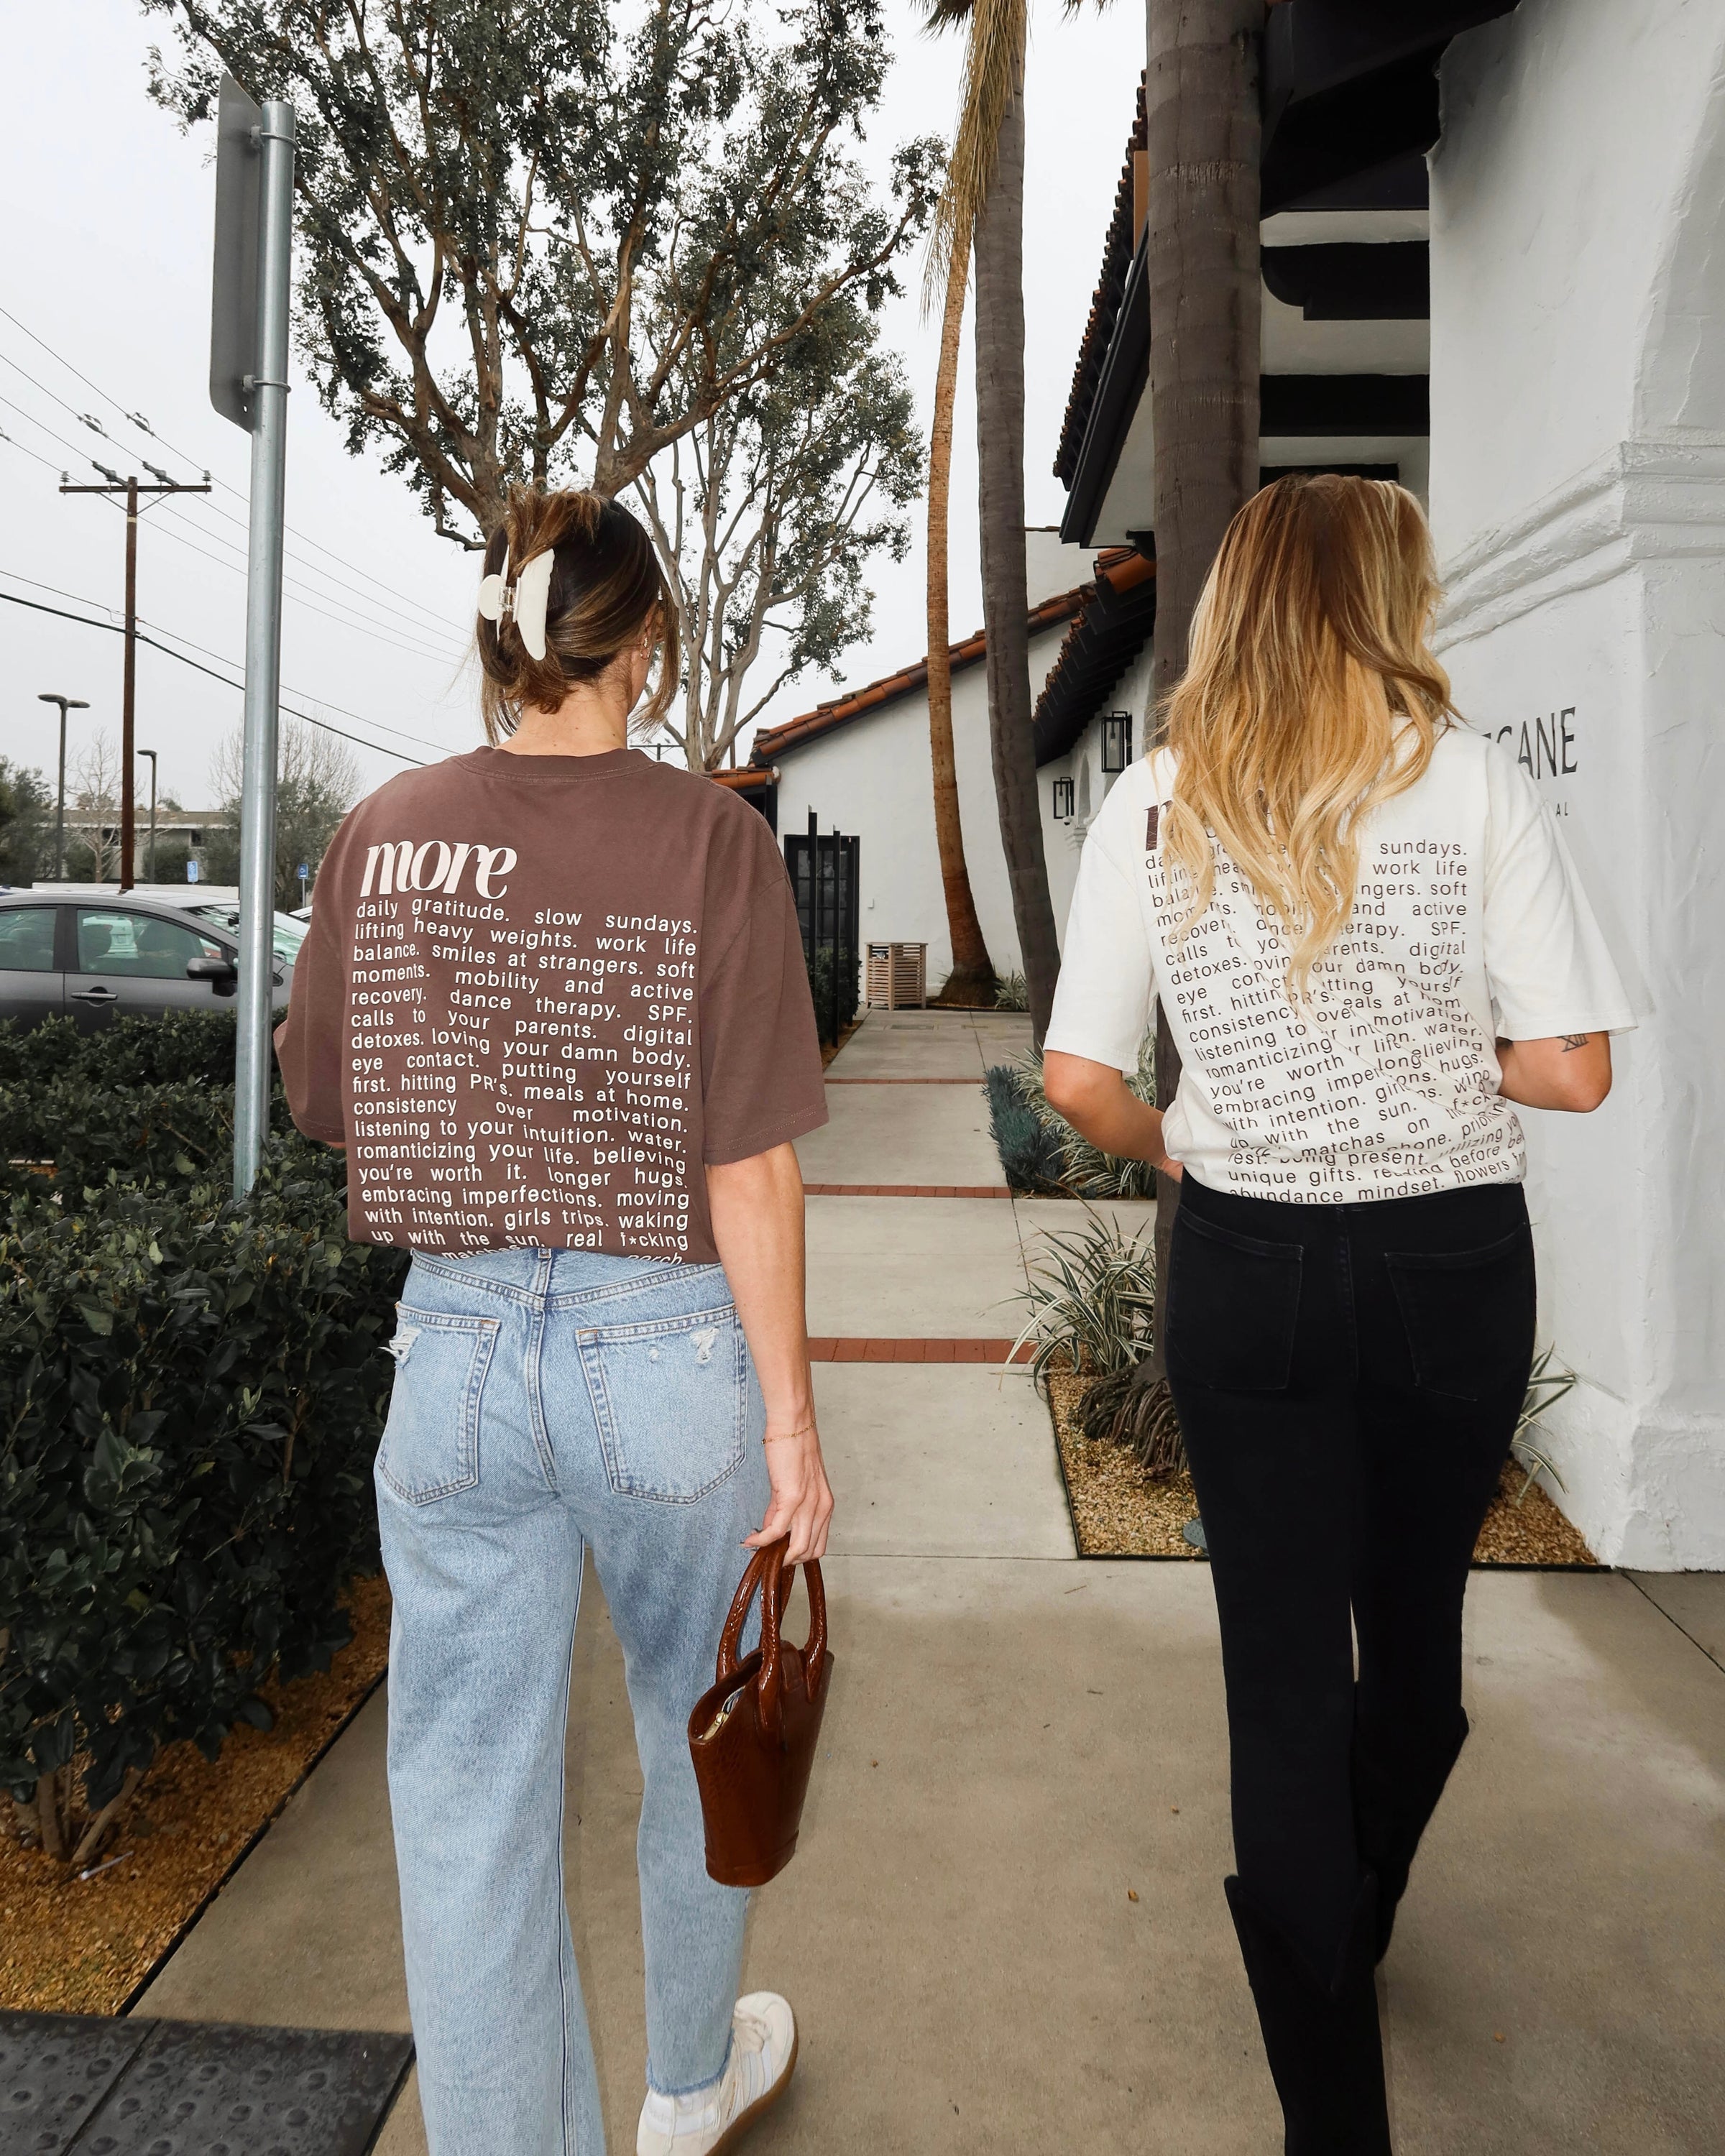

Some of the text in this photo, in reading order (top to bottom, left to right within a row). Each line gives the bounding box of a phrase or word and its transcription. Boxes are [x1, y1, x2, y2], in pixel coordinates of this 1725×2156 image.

[1482, 706, 1578, 780] ANE
[1380, 839, 1467, 859] sundays.
[359, 840, 518, 900] more
[1372, 859, 1420, 875] work
[1436, 860, 1467, 877] life
[1430, 880, 1467, 896] soft
[356, 898, 697, 936] daily gratitude. slow sundays.
[1412, 901, 1467, 916] active
[354, 916, 696, 957] lifting heavy weights. work life
[1161, 919, 1236, 946] recover.
[1340, 923, 1405, 939] erapy.
[1431, 921, 1466, 936] SPF.
[353, 943, 695, 979] balance. smiles at strangers. soft
[1165, 944, 1208, 966] calls
[1409, 939, 1466, 960] digital
[1171, 956, 1247, 985] detoxes.
[1254, 955, 1292, 970] ovin
[1312, 961, 1343, 973] our
[1356, 958, 1405, 975] damn
[352, 963, 694, 1001] moments. mobility and active
[1177, 987, 1208, 1006] eye
[1231, 972, 1294, 990] conct.
[1397, 976, 1462, 992] yourslf
[351, 987, 692, 1024] recovery. dance therapy. SPF.
[1182, 1004, 1222, 1024] first.
[1230, 988, 1282, 1011] hittin
[1343, 996, 1382, 1009] eals
[1394, 991, 1411, 1007] at
[351, 1008, 692, 1046] calls to your parents. digital
[1189, 1005, 1299, 1043] consistency
[1194, 1032, 1276, 1061] listening
[1286, 1024, 1307, 1038] to
[1423, 1023, 1482, 1038] water.
[351, 1027, 691, 1071] detoxes. loving your damn body.
[1205, 1038, 1333, 1079] romanticizing
[1412, 1037, 1482, 1059] elieving
[351, 1051, 691, 1089] eye contact. putting yourself
[1210, 1078, 1265, 1100] you're
[1286, 1054, 1345, 1082] worth
[1439, 1054, 1484, 1075] hugs.
[352, 1073, 689, 1112] first. hitting PR's. meals at home.
[1213, 1086, 1316, 1115] embracing
[354, 1097, 687, 1133] consistency over motivation.
[1264, 1128, 1309, 1145] with
[1326, 1117, 1360, 1135] the
[1378, 1102, 1417, 1121] sun.
[1269, 1095, 1366, 1128] intention.
[355, 1119, 686, 1153] listening to your intuition. water.
[1302, 1133, 1385, 1156] matchas
[1407, 1118, 1430, 1134] on
[356, 1141, 686, 1175] romanticizing your life. believing
[1228, 1170, 1297, 1187] unique
[1309, 1167, 1361, 1187] gifts.
[1449, 1146, 1501, 1168] before
[358, 1163, 687, 1190] you're worth it. longer hugs.
[1358, 1176, 1445, 1200] mindset.
[362, 1184, 689, 1210] embracing imperfections. moving
[364, 1207, 689, 1231] with intention. girls trips. waking
[371, 1230, 394, 1244] up
[408, 1229, 446, 1245] with
[459, 1230, 490, 1245] the
[505, 1235, 545, 1248] sun.
[566, 1229, 603, 1248] real
